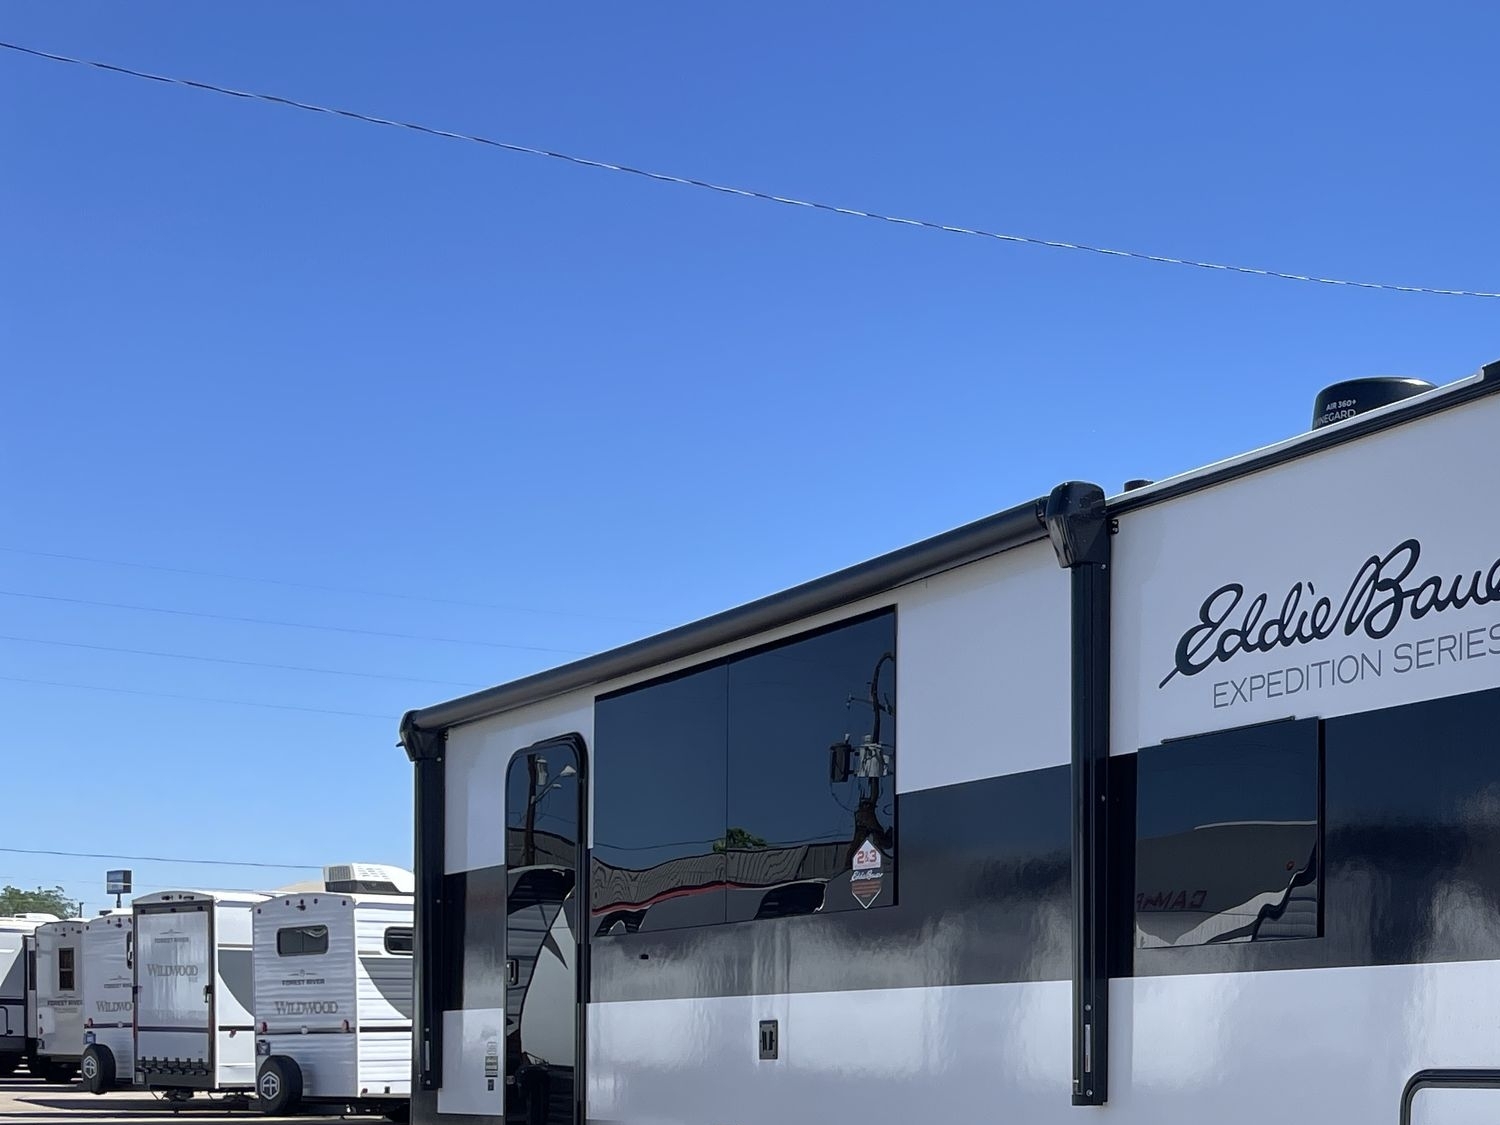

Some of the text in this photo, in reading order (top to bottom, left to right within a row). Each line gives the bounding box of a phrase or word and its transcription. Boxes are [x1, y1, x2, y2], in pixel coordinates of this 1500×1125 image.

[1158, 580, 1332, 689] Eddie
[1212, 649, 1382, 709] EXPEDITION
[96, 1000, 132, 1013] WILDWO
[274, 1000, 339, 1015] WILDWOOD
